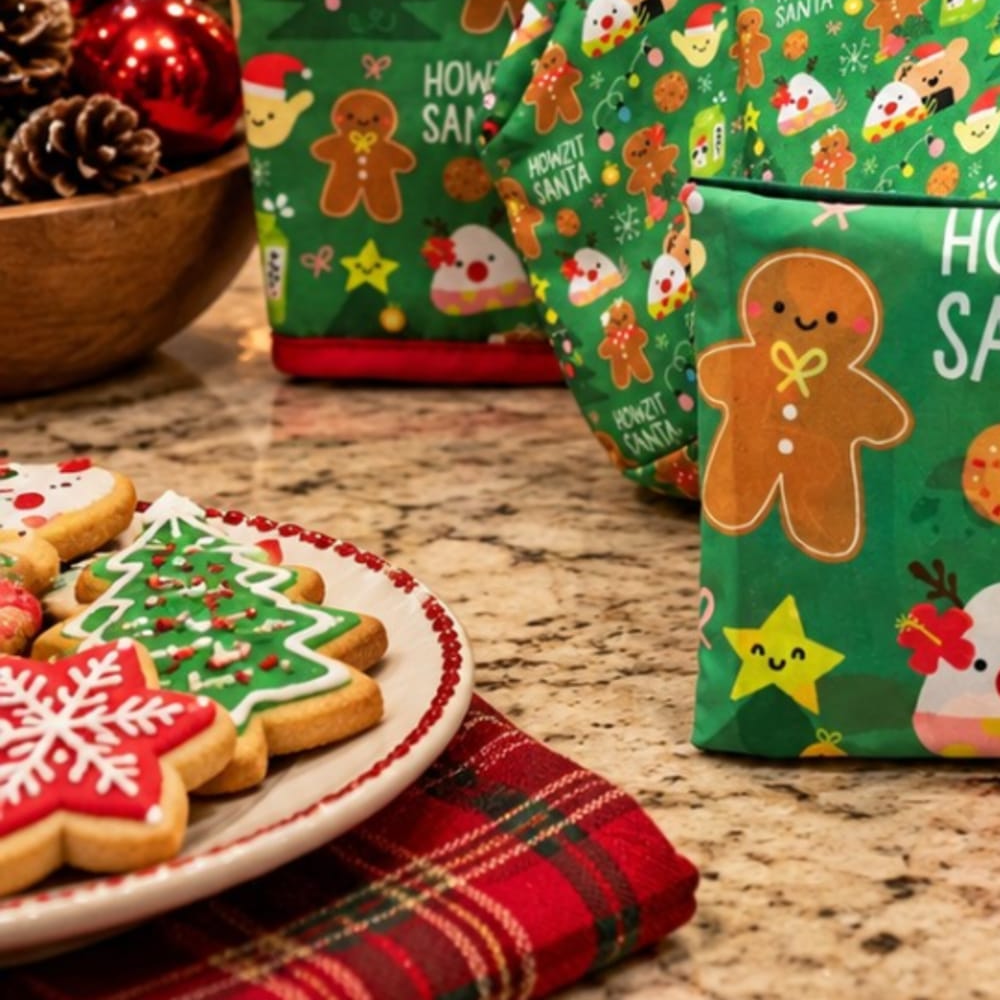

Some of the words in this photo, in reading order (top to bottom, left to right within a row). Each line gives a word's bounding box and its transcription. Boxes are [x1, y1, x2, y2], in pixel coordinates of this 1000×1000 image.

[423, 60, 500, 98] HOW
[528, 133, 584, 179] HOWZIT
[533, 162, 592, 206] SANTA
